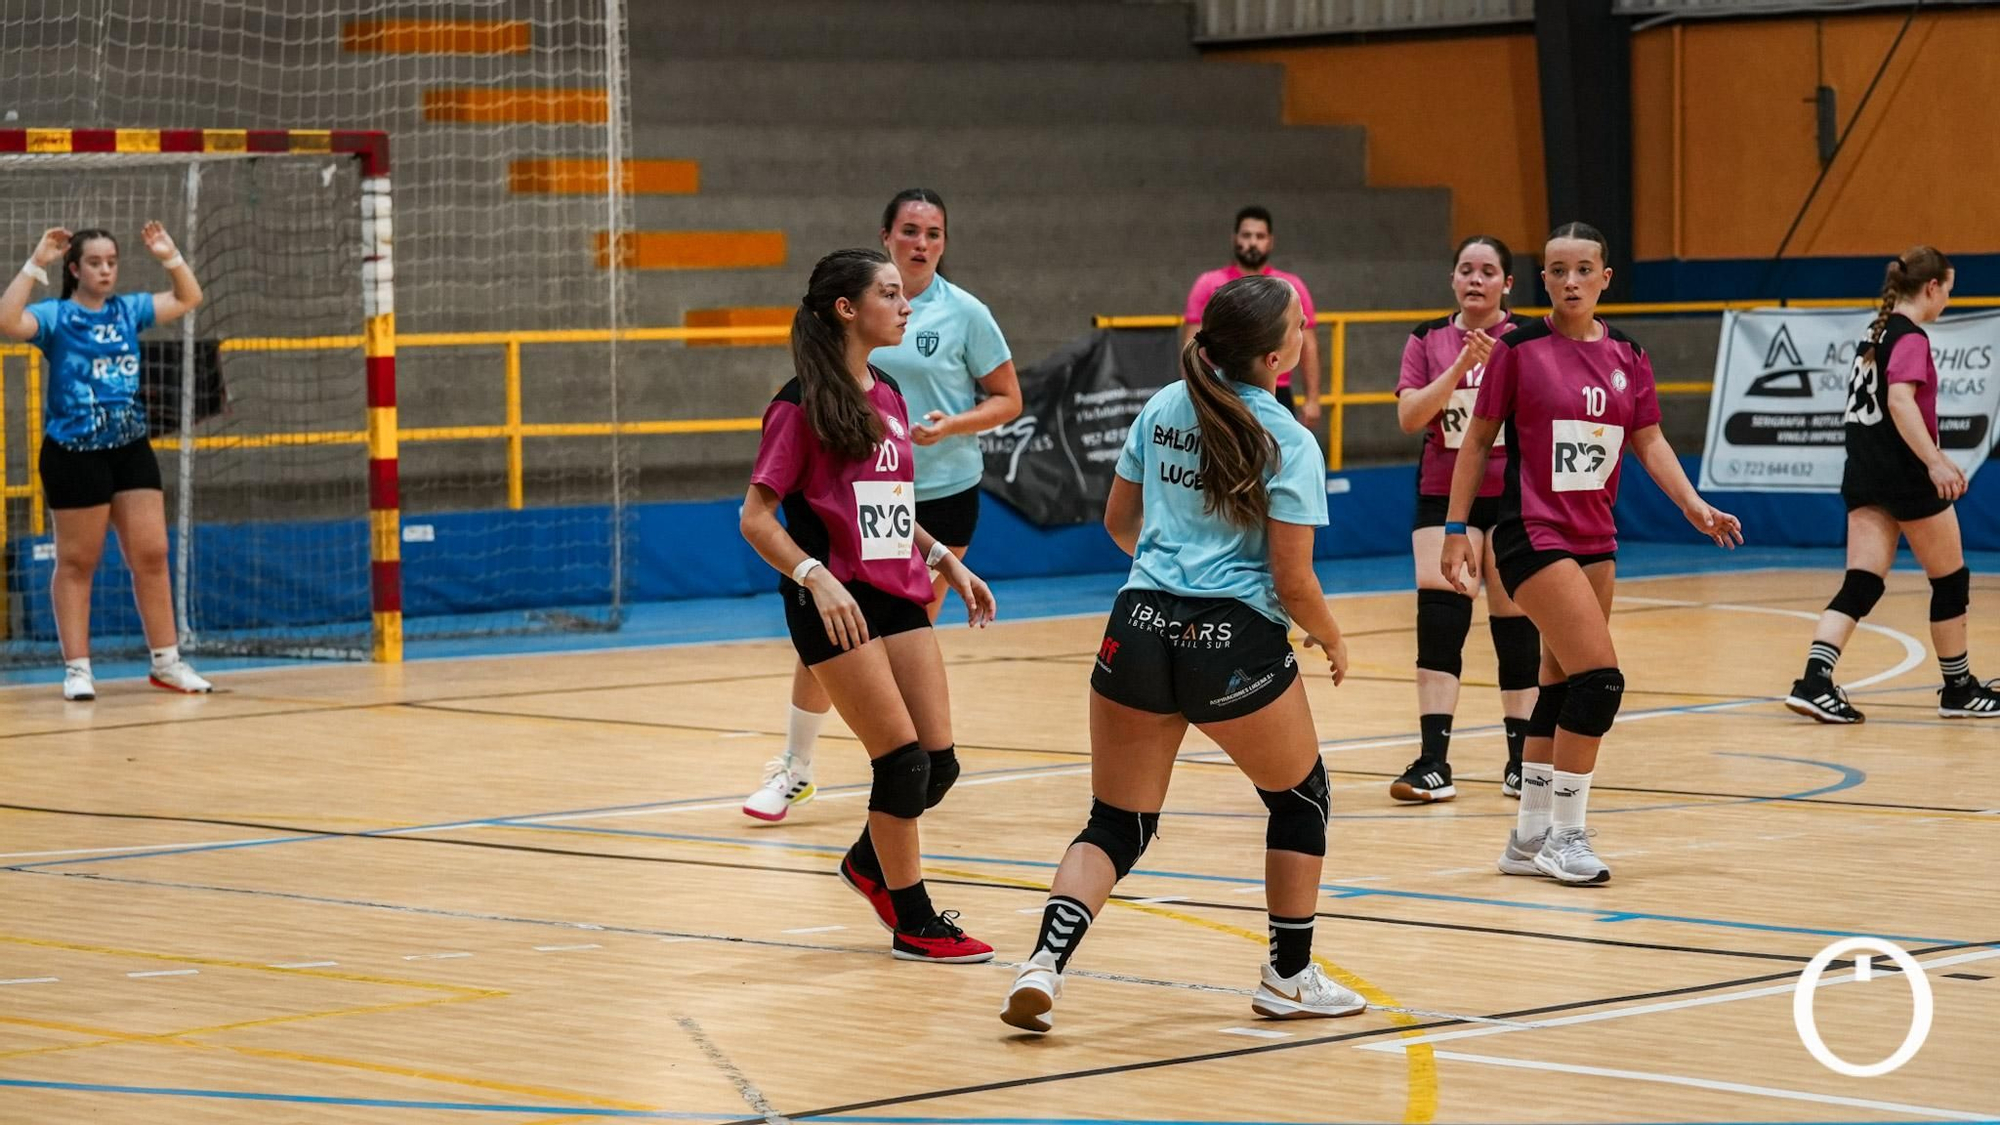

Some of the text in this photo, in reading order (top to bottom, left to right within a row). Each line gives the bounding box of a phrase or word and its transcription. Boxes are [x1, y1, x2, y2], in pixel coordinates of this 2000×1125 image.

[1582, 386, 1607, 418] 10
[1844, 355, 1884, 427] 23
[873, 438, 899, 472] 20
[859, 504, 911, 539] RYG
